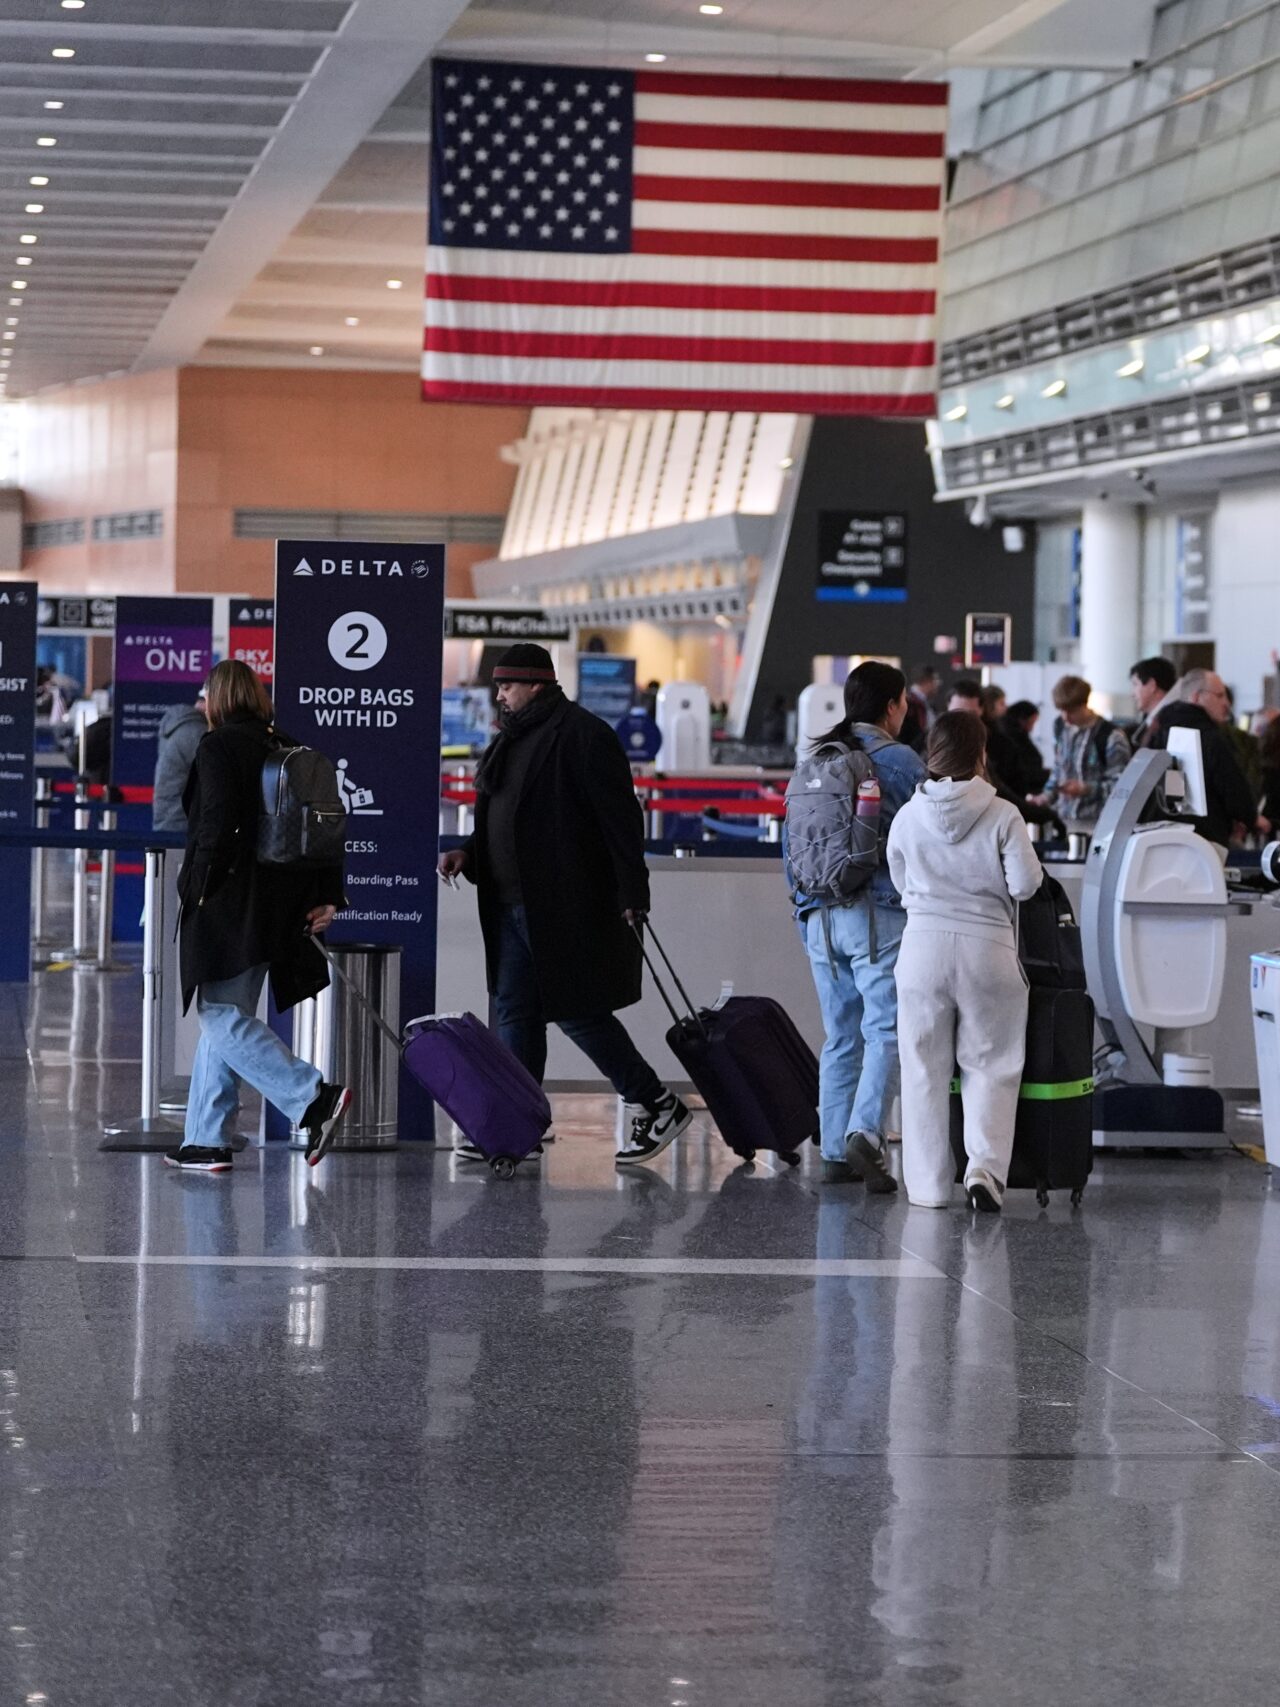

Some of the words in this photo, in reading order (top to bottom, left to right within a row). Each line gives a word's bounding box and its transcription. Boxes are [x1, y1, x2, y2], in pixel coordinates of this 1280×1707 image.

[321, 559, 403, 576] DELTA
[456, 615, 489, 633] TSA
[135, 635, 173, 646] DELTA
[345, 623, 369, 658] 2
[974, 631, 1003, 647] EXIT
[145, 648, 203, 672] ONE
[234, 648, 269, 662] SKY
[299, 687, 355, 705] DROP
[360, 688, 414, 706] BAGS
[314, 709, 371, 727] WITH
[376, 710, 397, 728] ID
[344, 840, 377, 853] CESS:
[347, 874, 393, 888] Boarding
[395, 875, 419, 886] Pass
[391, 910, 422, 923] Ready
